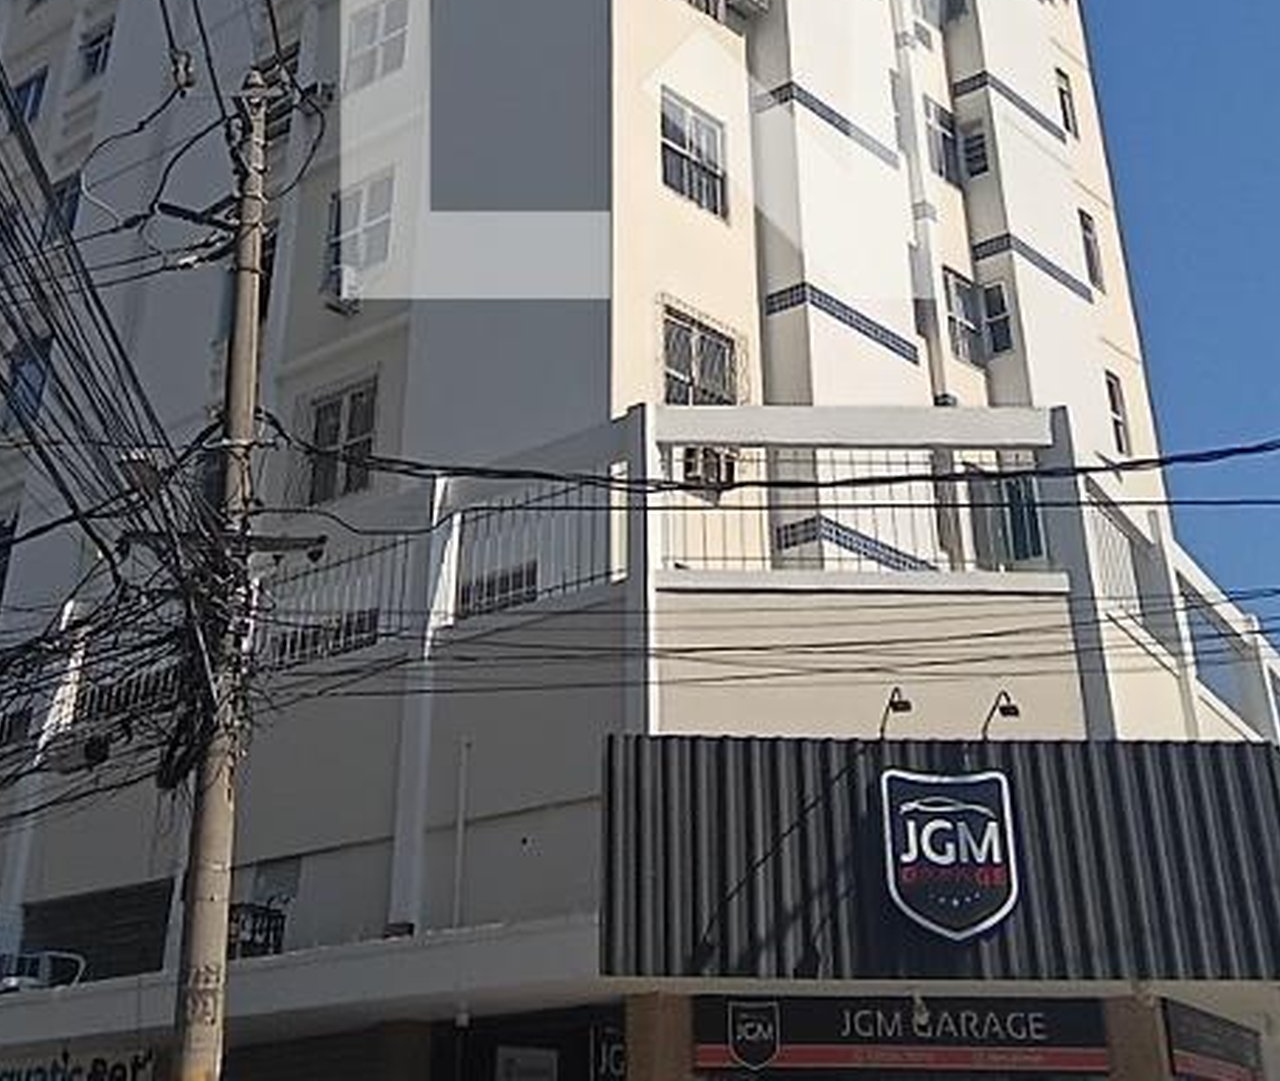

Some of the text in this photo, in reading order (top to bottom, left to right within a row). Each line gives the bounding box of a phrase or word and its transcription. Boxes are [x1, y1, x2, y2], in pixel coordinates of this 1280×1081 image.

[900, 818, 1003, 865] JGM
[841, 1009, 1047, 1039] JGM GARAGE
